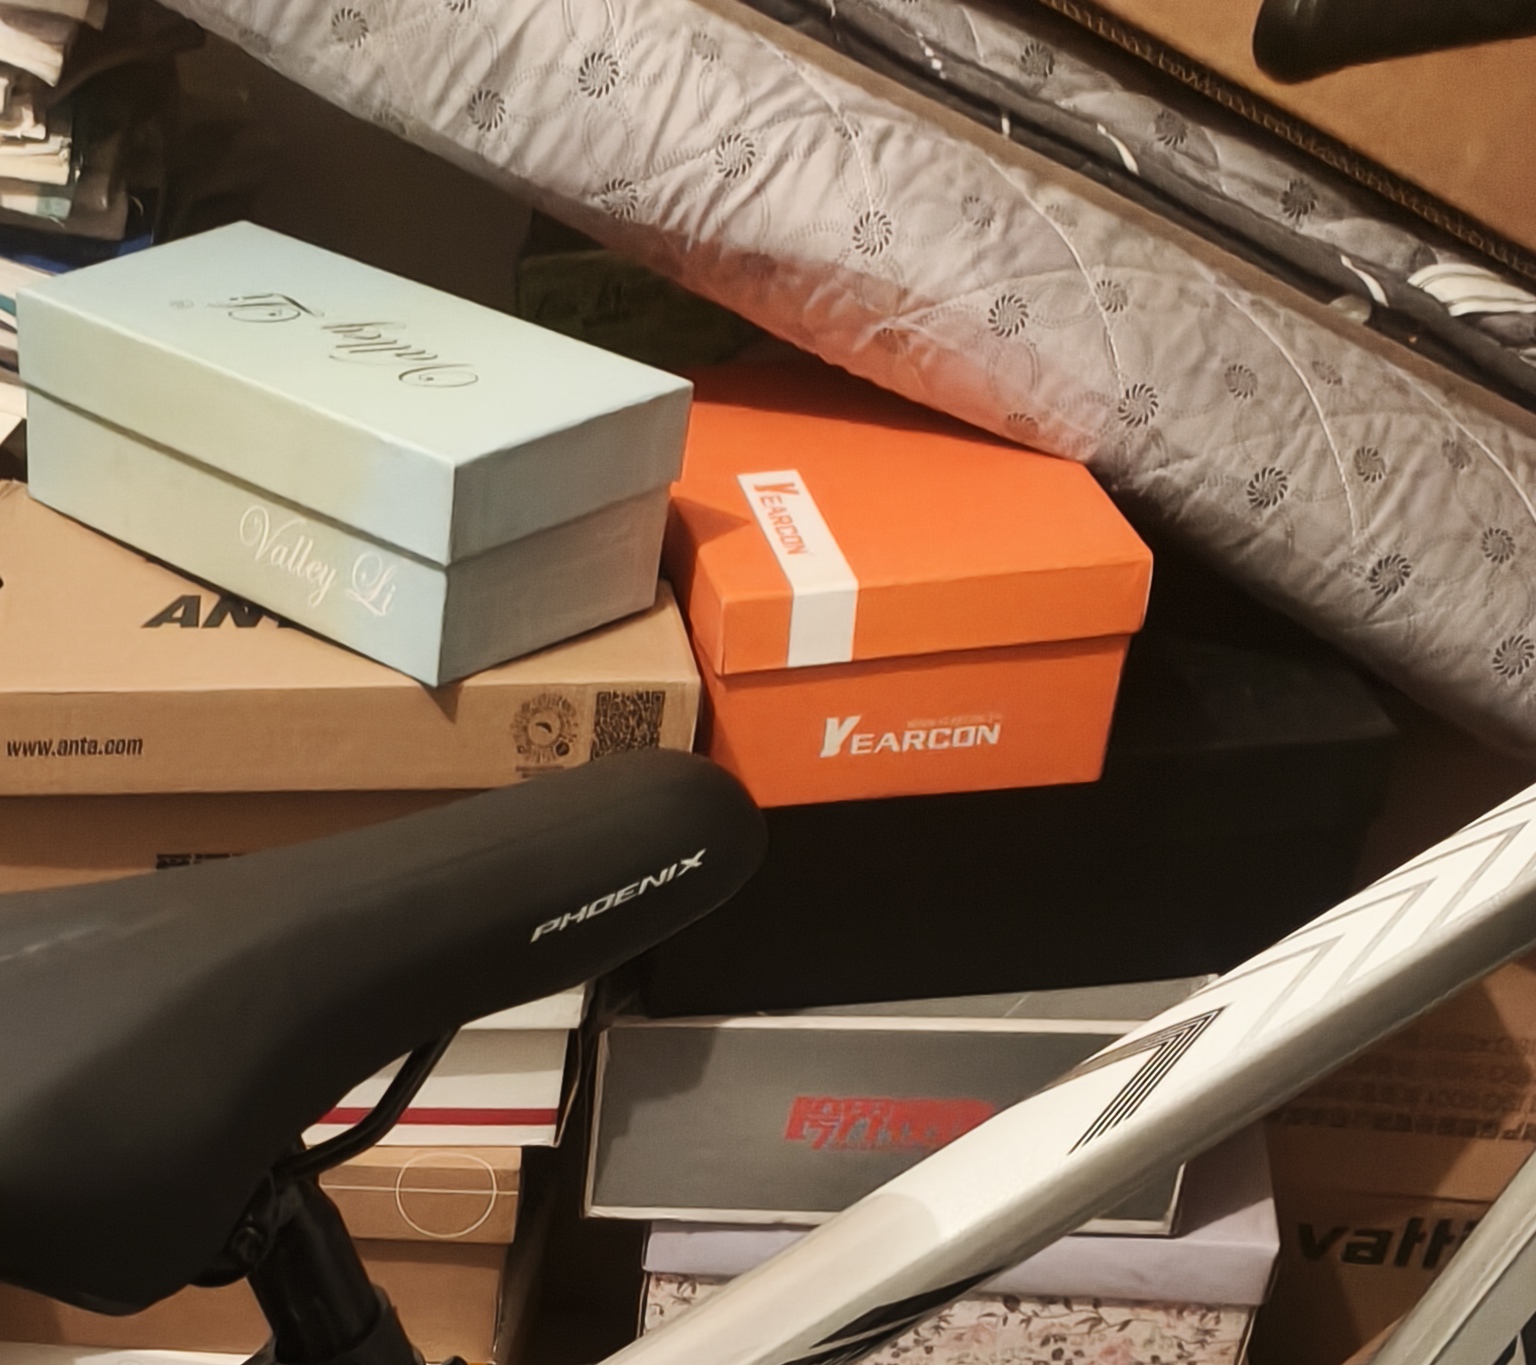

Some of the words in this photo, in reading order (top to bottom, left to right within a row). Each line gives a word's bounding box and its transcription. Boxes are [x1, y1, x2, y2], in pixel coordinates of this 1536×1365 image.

[753, 481, 808, 556] YEARCON
[240, 505, 336, 606] Valley
[346, 551, 396, 617] Li
[141, 594, 293, 628] AN
[6, 735, 144, 757] www.anta.com
[820, 714, 1002, 758] YEARCON
[530, 847, 707, 943] PHOENIX
[1297, 1216, 1477, 1269] vatt
